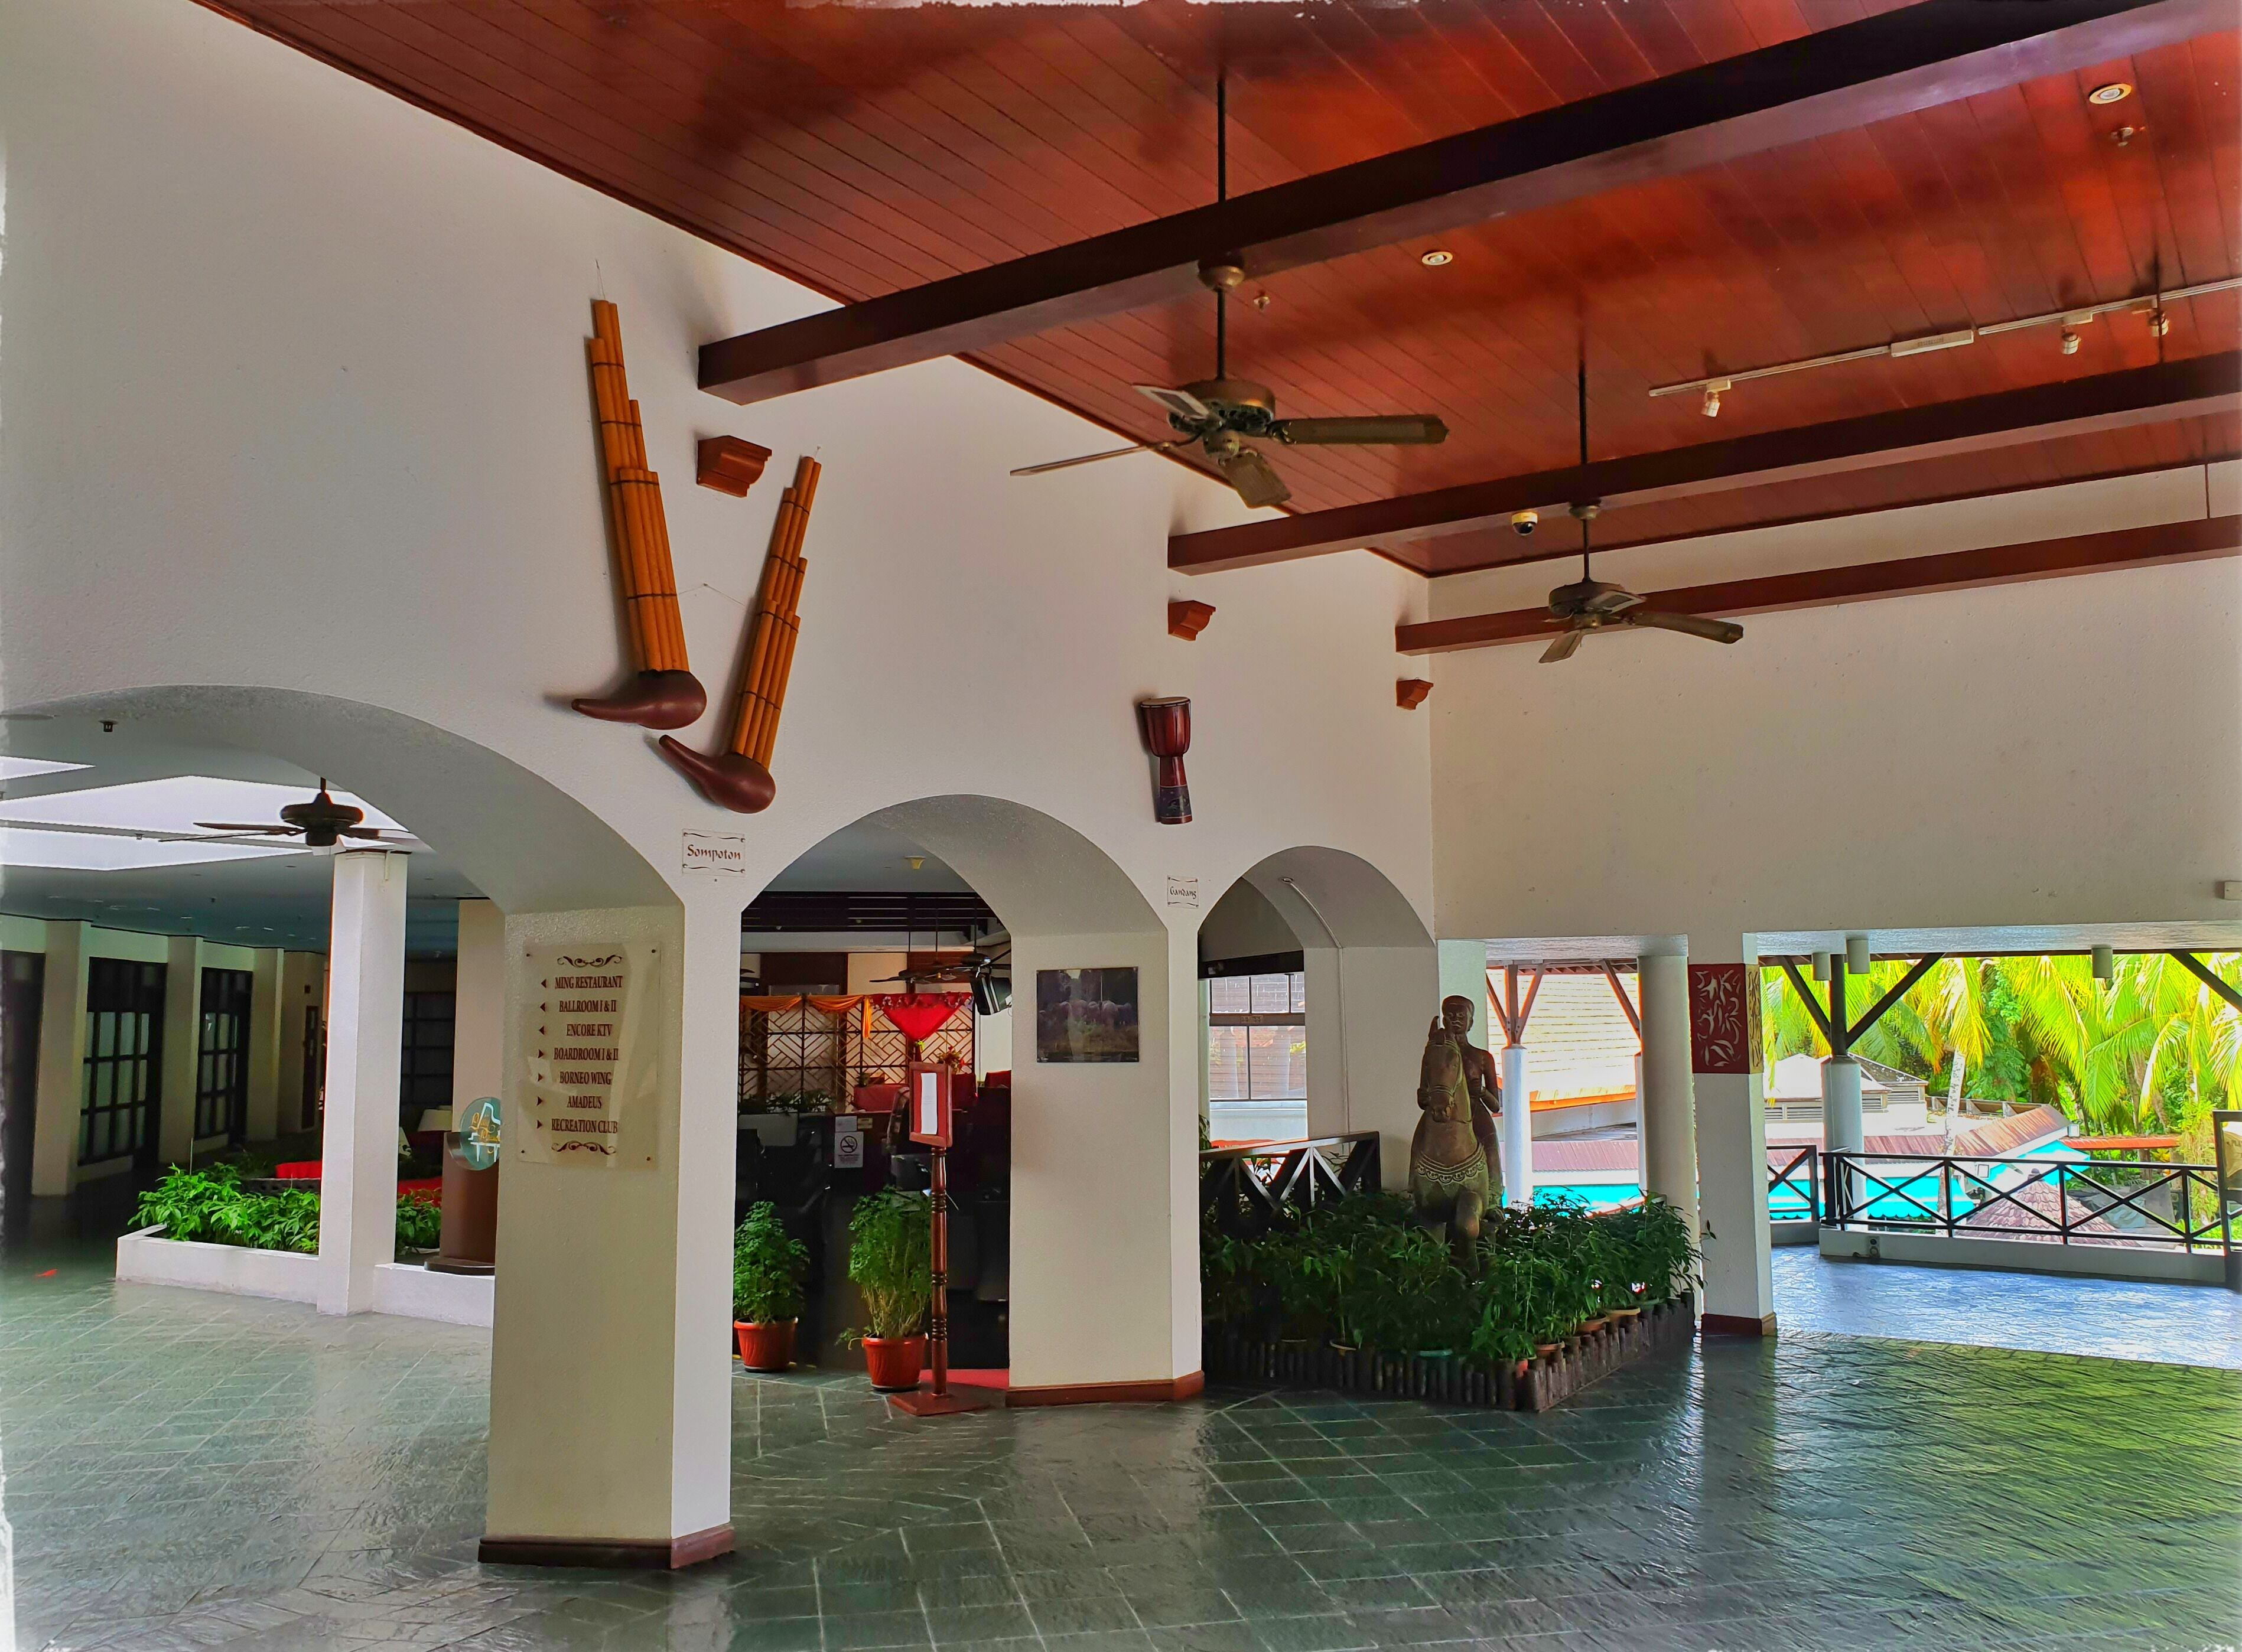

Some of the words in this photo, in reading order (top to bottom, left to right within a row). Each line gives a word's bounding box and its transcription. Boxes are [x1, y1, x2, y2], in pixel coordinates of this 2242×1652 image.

[687, 844, 741, 862] Sompoton
[1170, 886, 1196, 899] Gandang
[555, 976, 574, 989] MING
[575, 976, 623, 988] RESTAURANT
[559, 1000, 598, 1012] BALLROOM
[604, 1001, 610, 1012] &
[611, 1000, 617, 1012] II
[567, 1024, 596, 1036] ENCORE
[597, 1024, 613, 1036] KTV
[554, 1047, 600, 1060] BOARDROOM
[606, 1048, 612, 1060] &
[613, 1048, 619, 1060] II
[559, 1071, 590, 1084] BORNEO
[591, 1071, 612, 1084] WING
[567, 1096, 602, 1109] AMADEUS
[551, 1118, 596, 1132] RECREATION
[598, 1120, 618, 1133] CLUB
